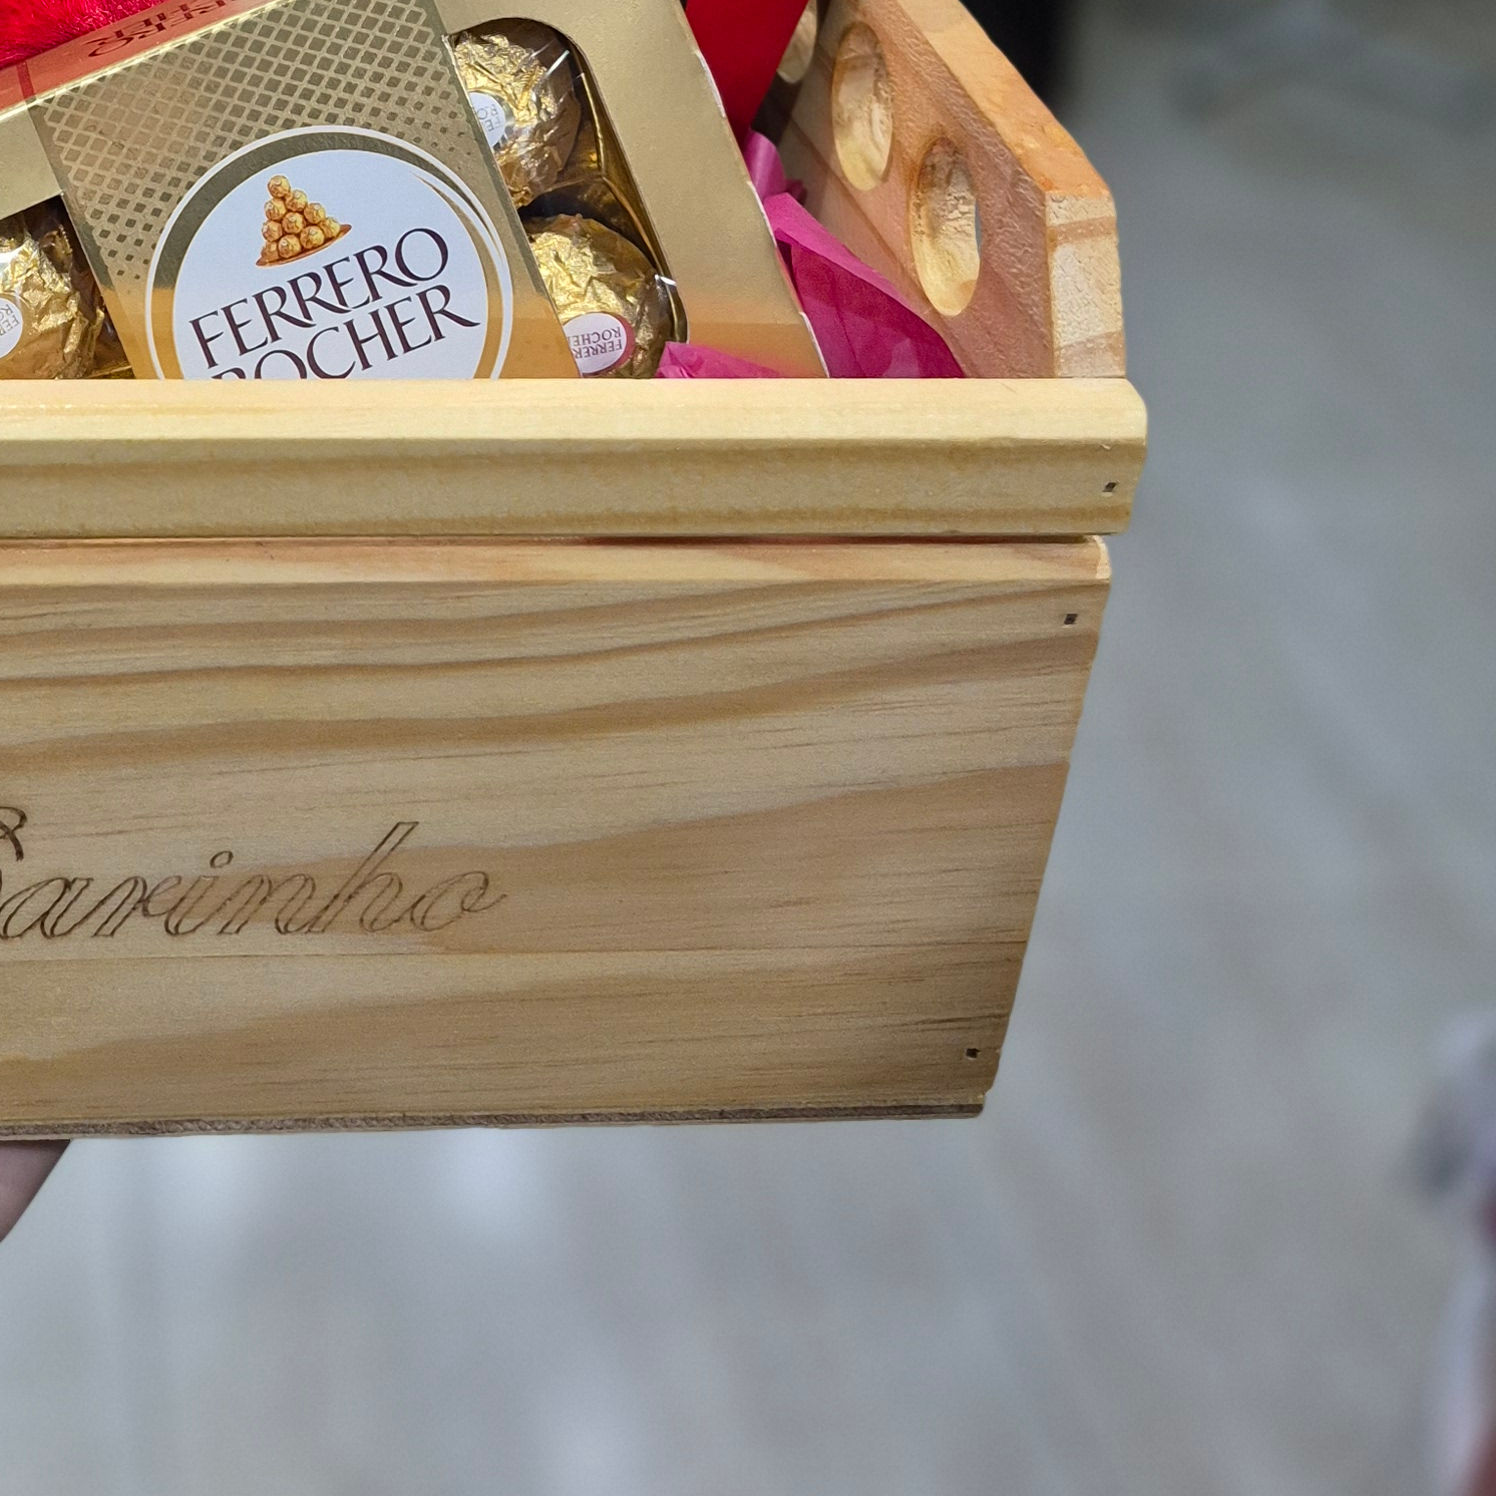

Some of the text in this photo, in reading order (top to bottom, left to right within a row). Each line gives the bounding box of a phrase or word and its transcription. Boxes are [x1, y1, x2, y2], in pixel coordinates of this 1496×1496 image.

[188, 227, 449, 370] FERRERO
[211, 283, 482, 379] OCHER
[567, 326, 622, 348] ROCHE
[571, 338, 624, 360] FERRER
